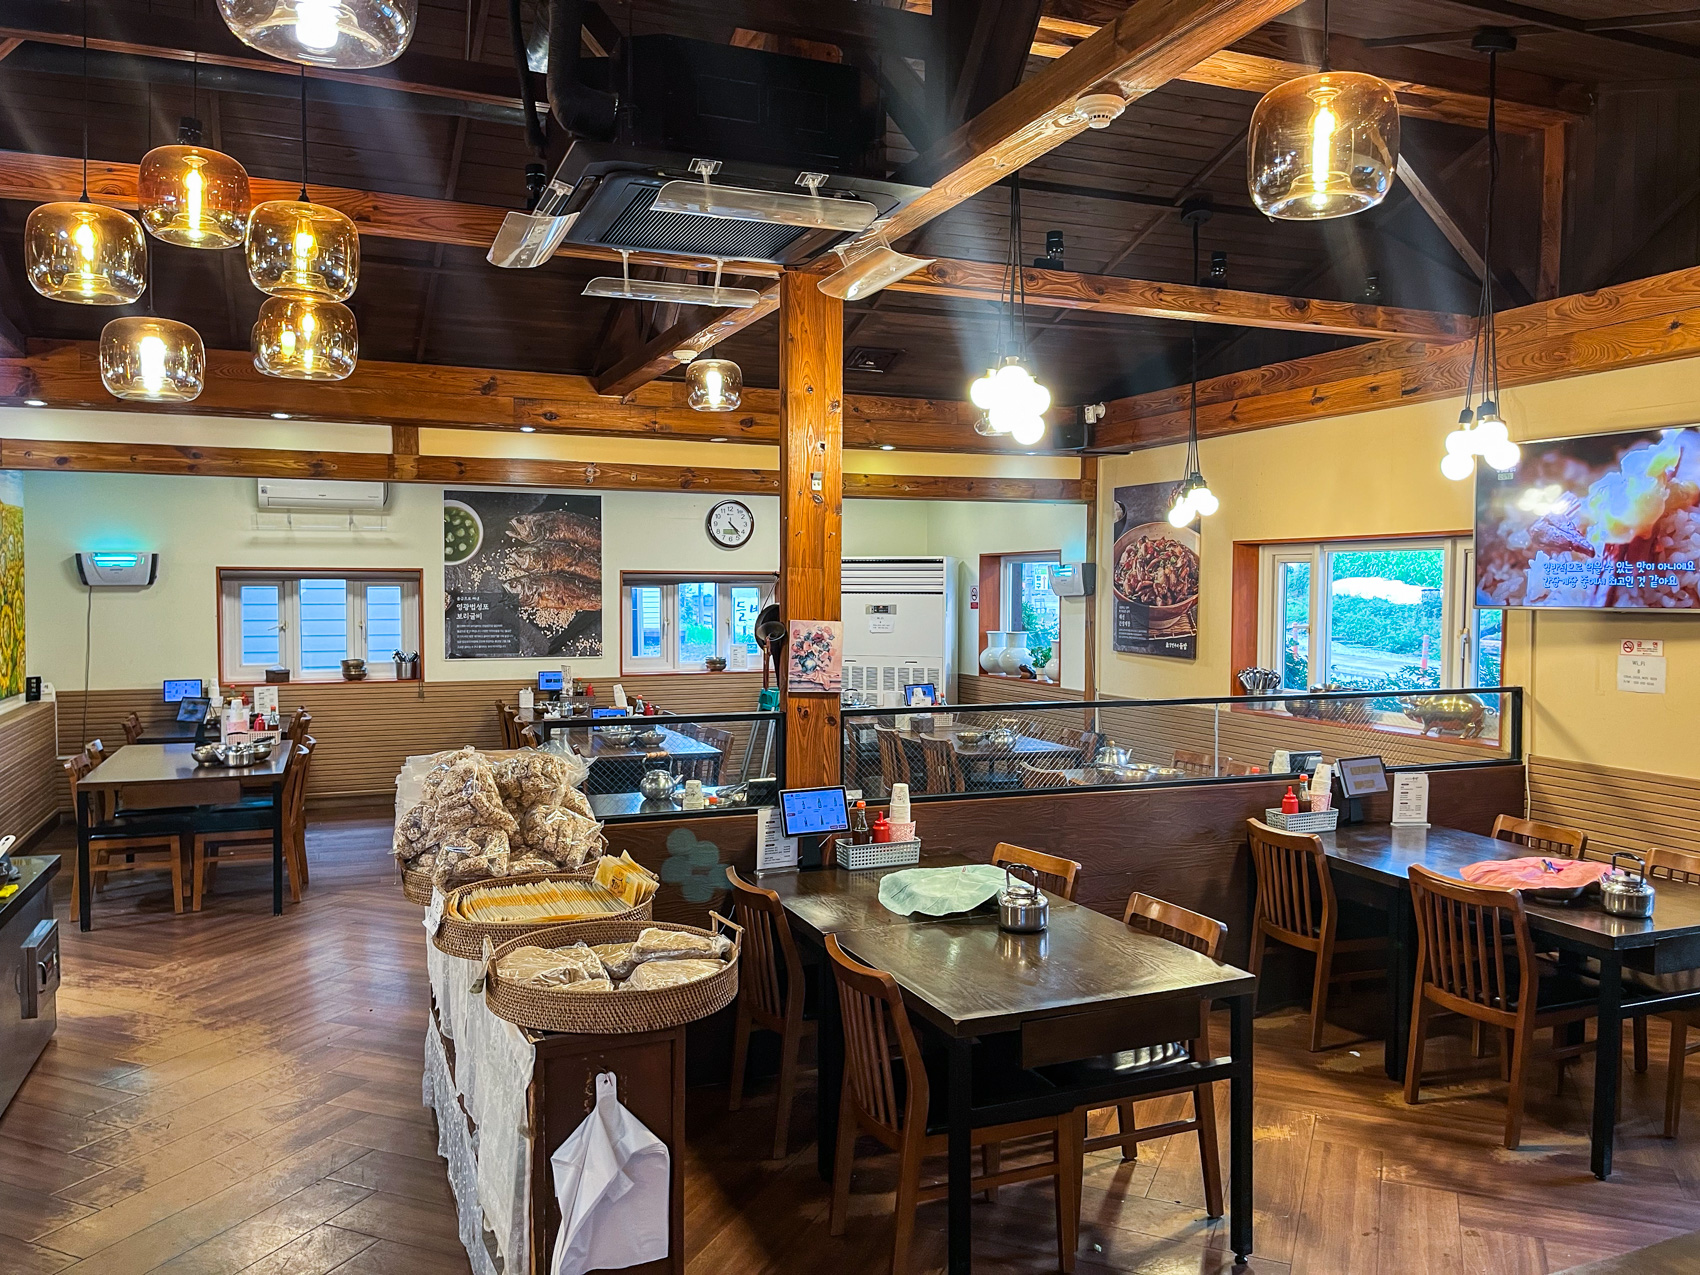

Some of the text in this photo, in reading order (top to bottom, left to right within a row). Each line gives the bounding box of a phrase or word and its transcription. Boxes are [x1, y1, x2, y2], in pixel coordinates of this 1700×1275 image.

[1543, 563, 1583, 575] 일반적으로
[1616, 561, 1634, 573] 있는
[1636, 561, 1654, 573] 맛이
[1657, 560, 1695, 571] 아니에요
[1543, 575, 1678, 589] 간장게장 중에서 최고인 것 같아요
[456, 612, 482, 620] 보리굴비
